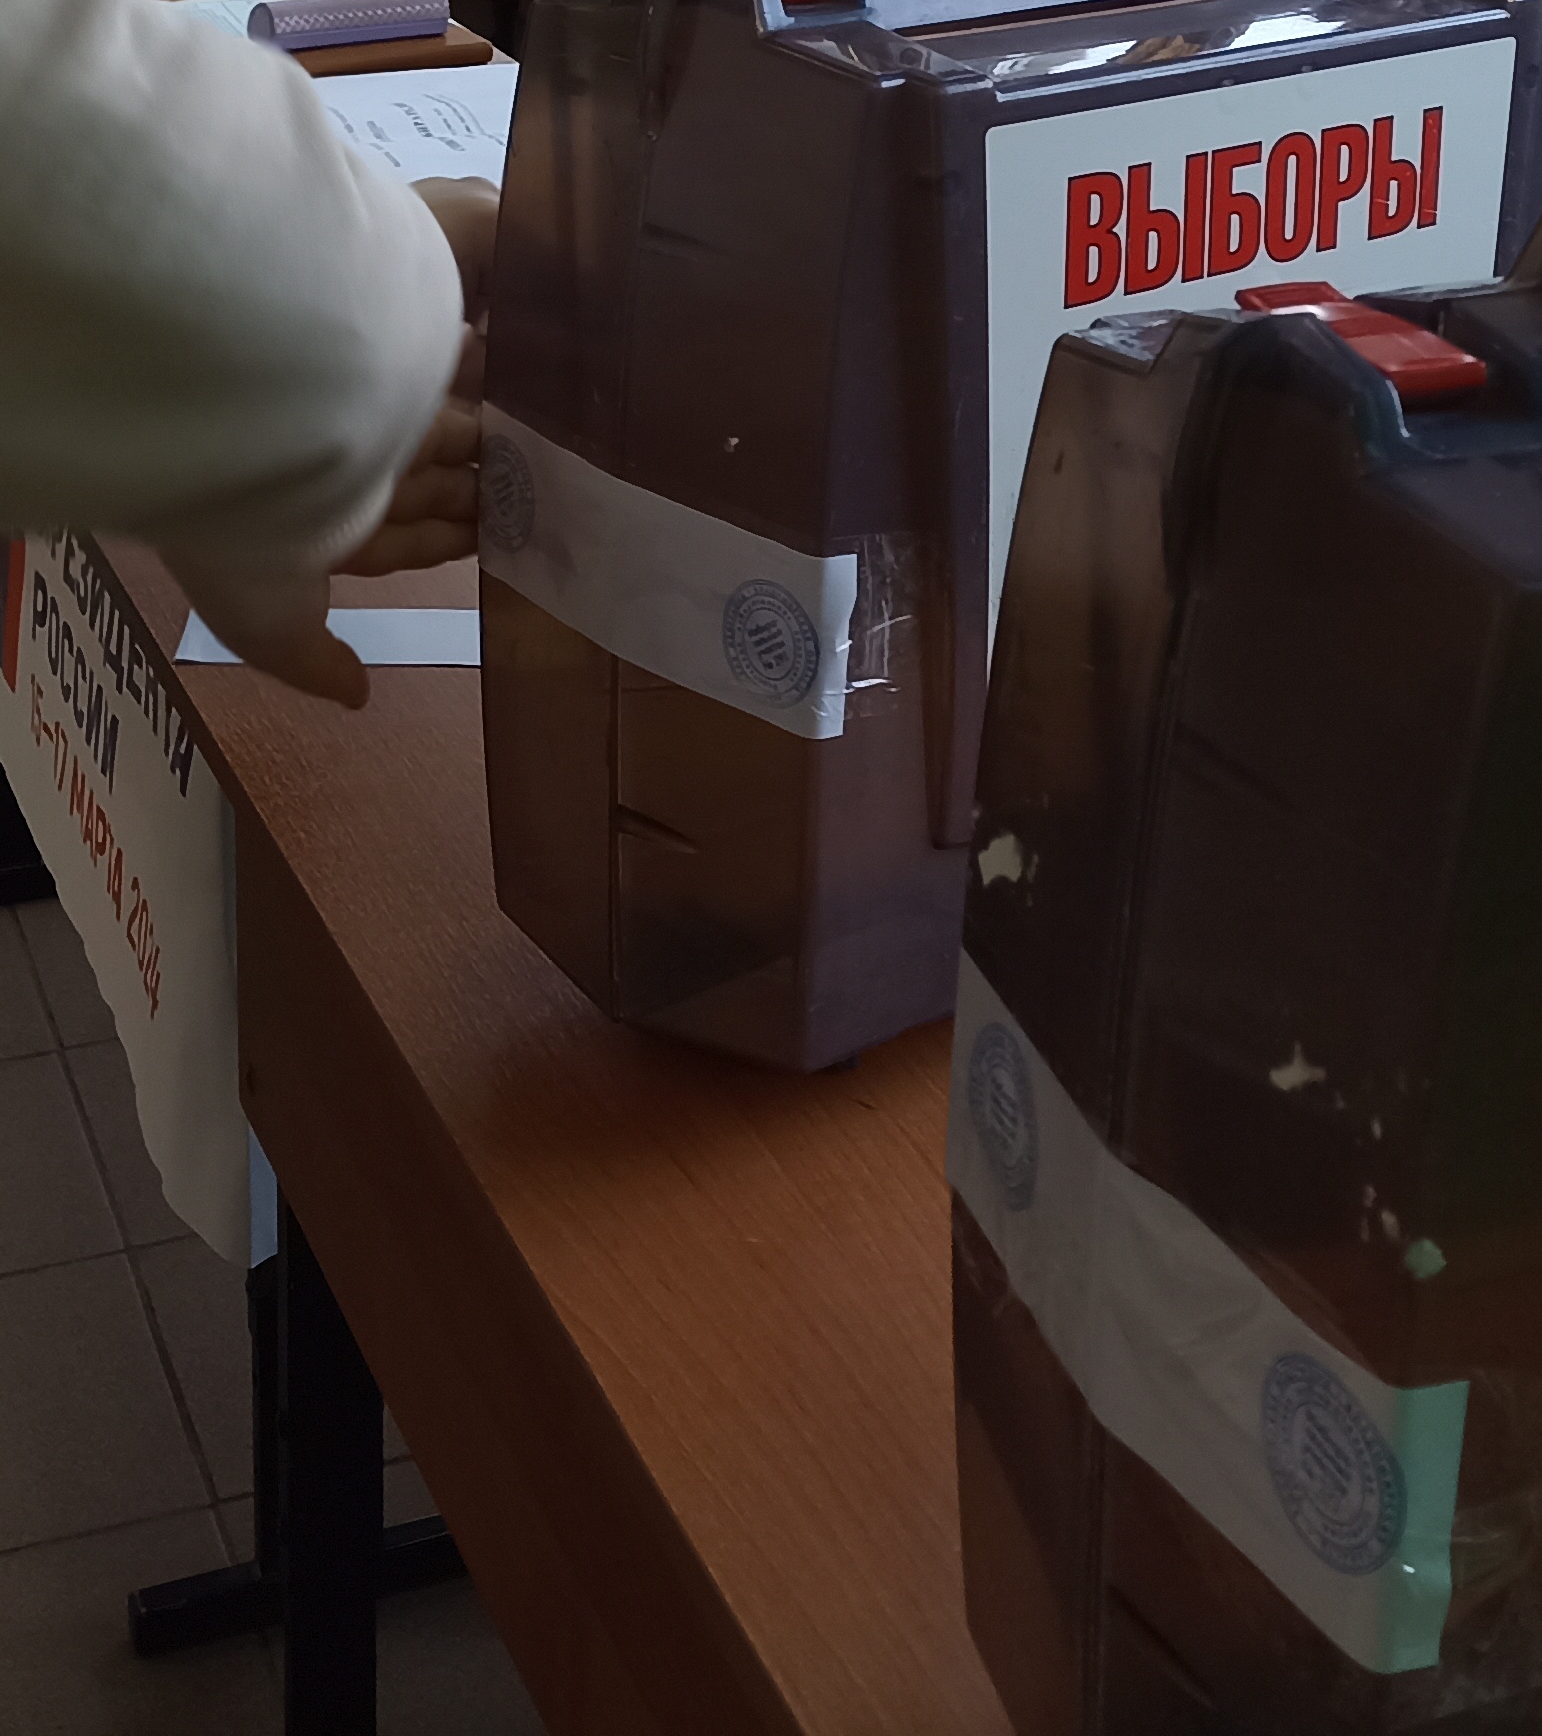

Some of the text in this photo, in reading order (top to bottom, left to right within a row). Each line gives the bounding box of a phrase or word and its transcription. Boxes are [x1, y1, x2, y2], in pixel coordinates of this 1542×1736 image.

[1063, 105, 1444, 310] ВЫБОРЫ
[32, 570, 119, 795] РОССИИ
[70, 754, 123, 922] МАРТА
